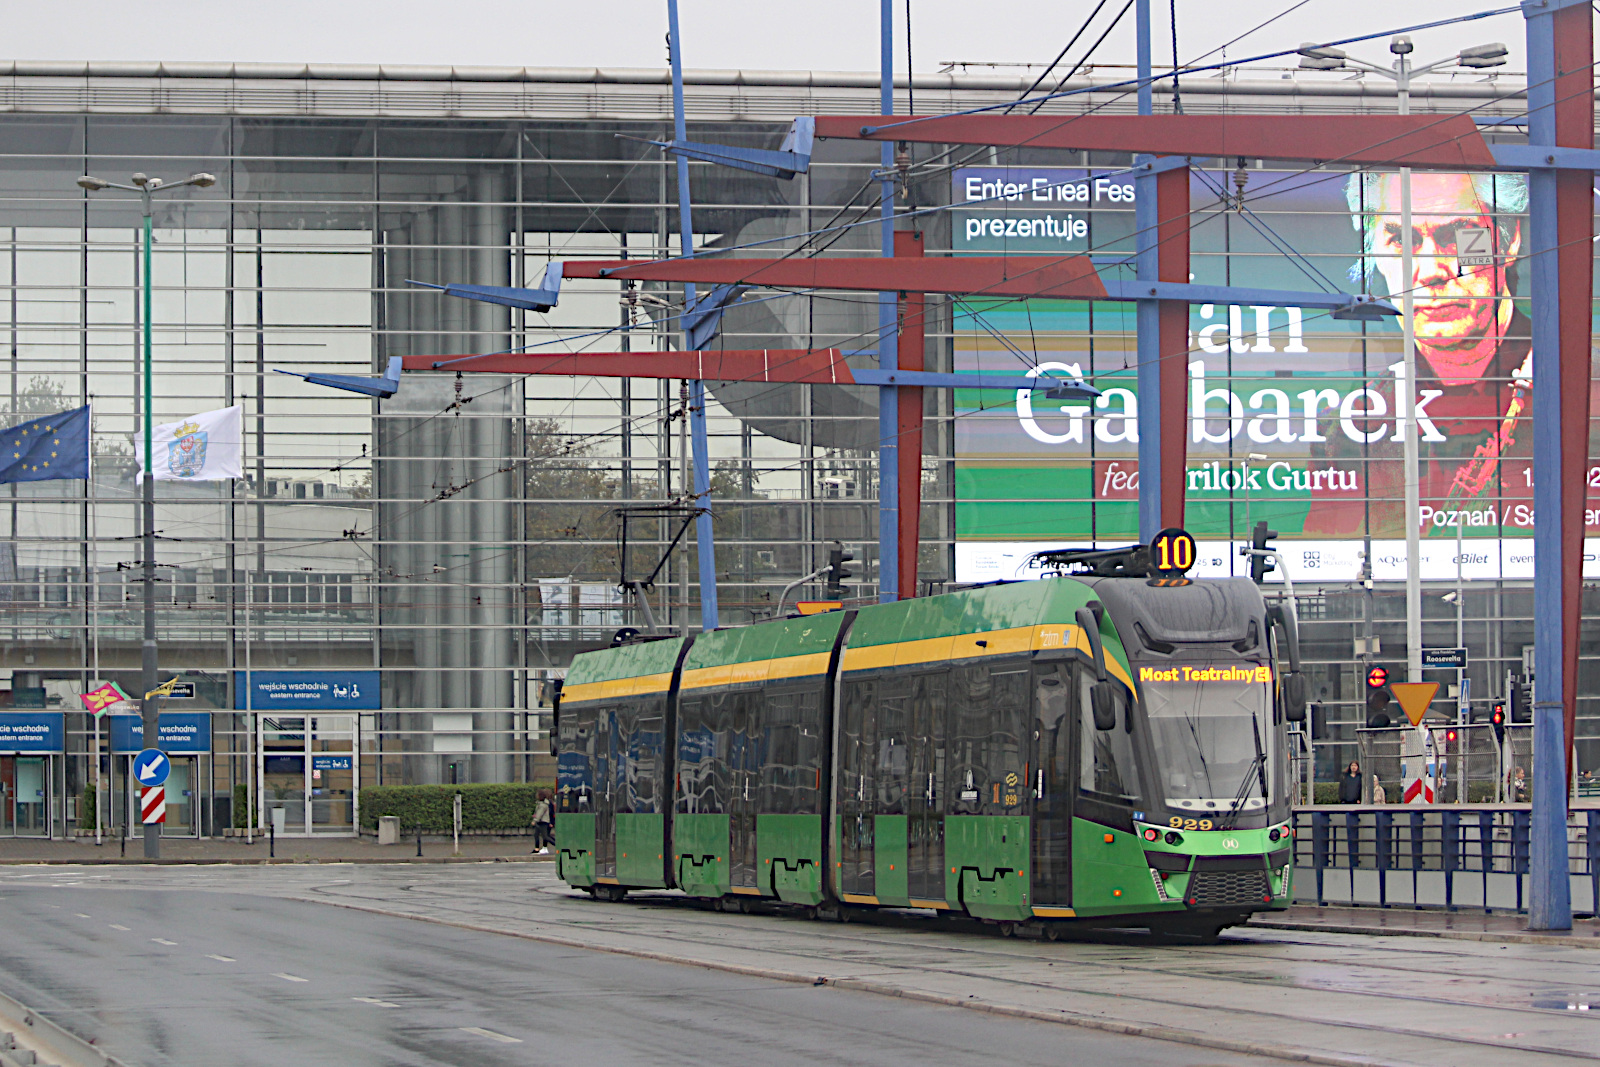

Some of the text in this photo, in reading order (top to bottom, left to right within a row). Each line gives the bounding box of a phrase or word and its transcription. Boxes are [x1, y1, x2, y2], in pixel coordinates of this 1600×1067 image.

[966, 177, 1027, 201] Enter
[1032, 178, 1088, 202] Enea
[966, 213, 1088, 241] prezentuje
[1189, 290, 1309, 354] an
[1015, 360, 1447, 445] Gabarek
[1186, 461, 1262, 491] rilok
[1266, 461, 1358, 491] Gurtu
[1418, 505, 1497, 527] Poznań
[1156, 535, 1192, 571] 10
[1452, 553, 1489, 564] eBilet
[1426, 655, 1461, 663] Roosevelta
[1140, 665, 1255, 684] Most Teatralny
[258, 682, 329, 692] wejście wschodnie
[12, 724, 50, 733] wschodnie
[160, 725, 197, 733] wschodnie
[1169, 815, 1213, 831] 929
